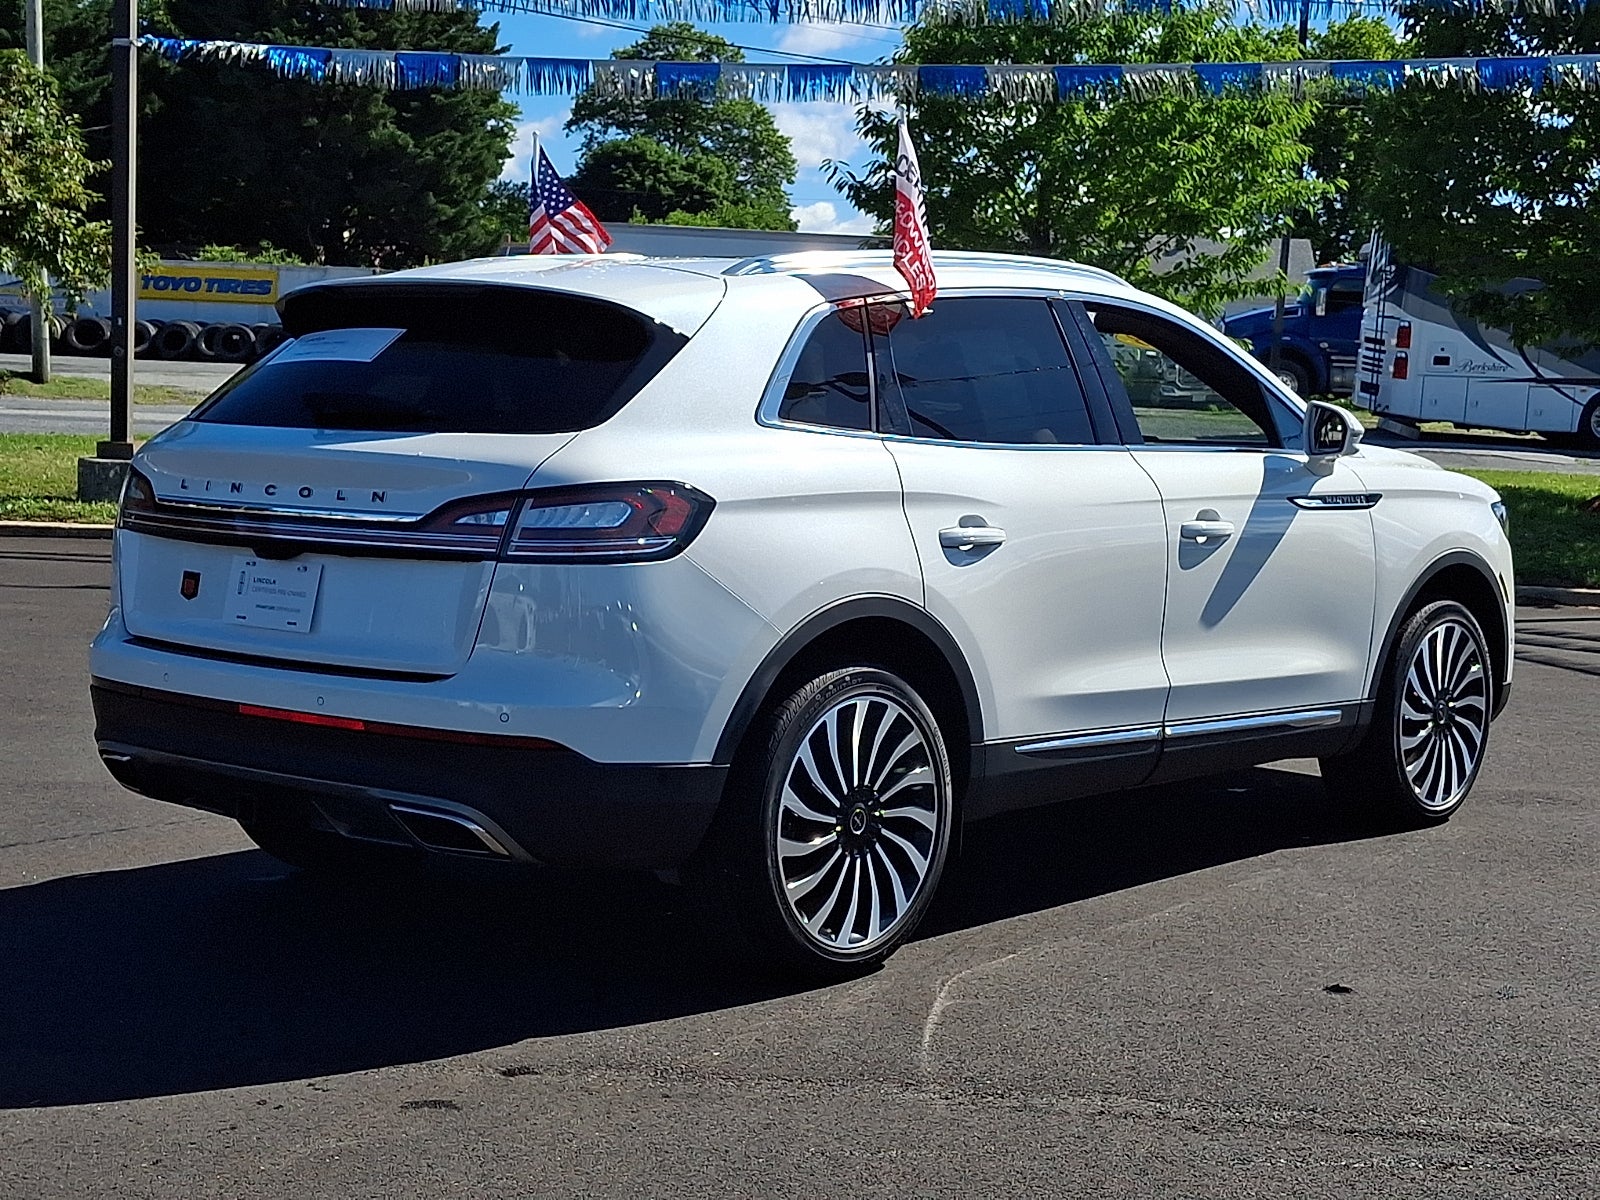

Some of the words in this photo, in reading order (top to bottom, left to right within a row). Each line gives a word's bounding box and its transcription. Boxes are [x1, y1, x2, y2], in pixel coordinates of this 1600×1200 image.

[141, 275, 202, 292] TOYO
[204, 277, 274, 295] TIRES
[1458, 359, 1509, 374] Berkshire
[180, 478, 387, 503] LINCOLN
